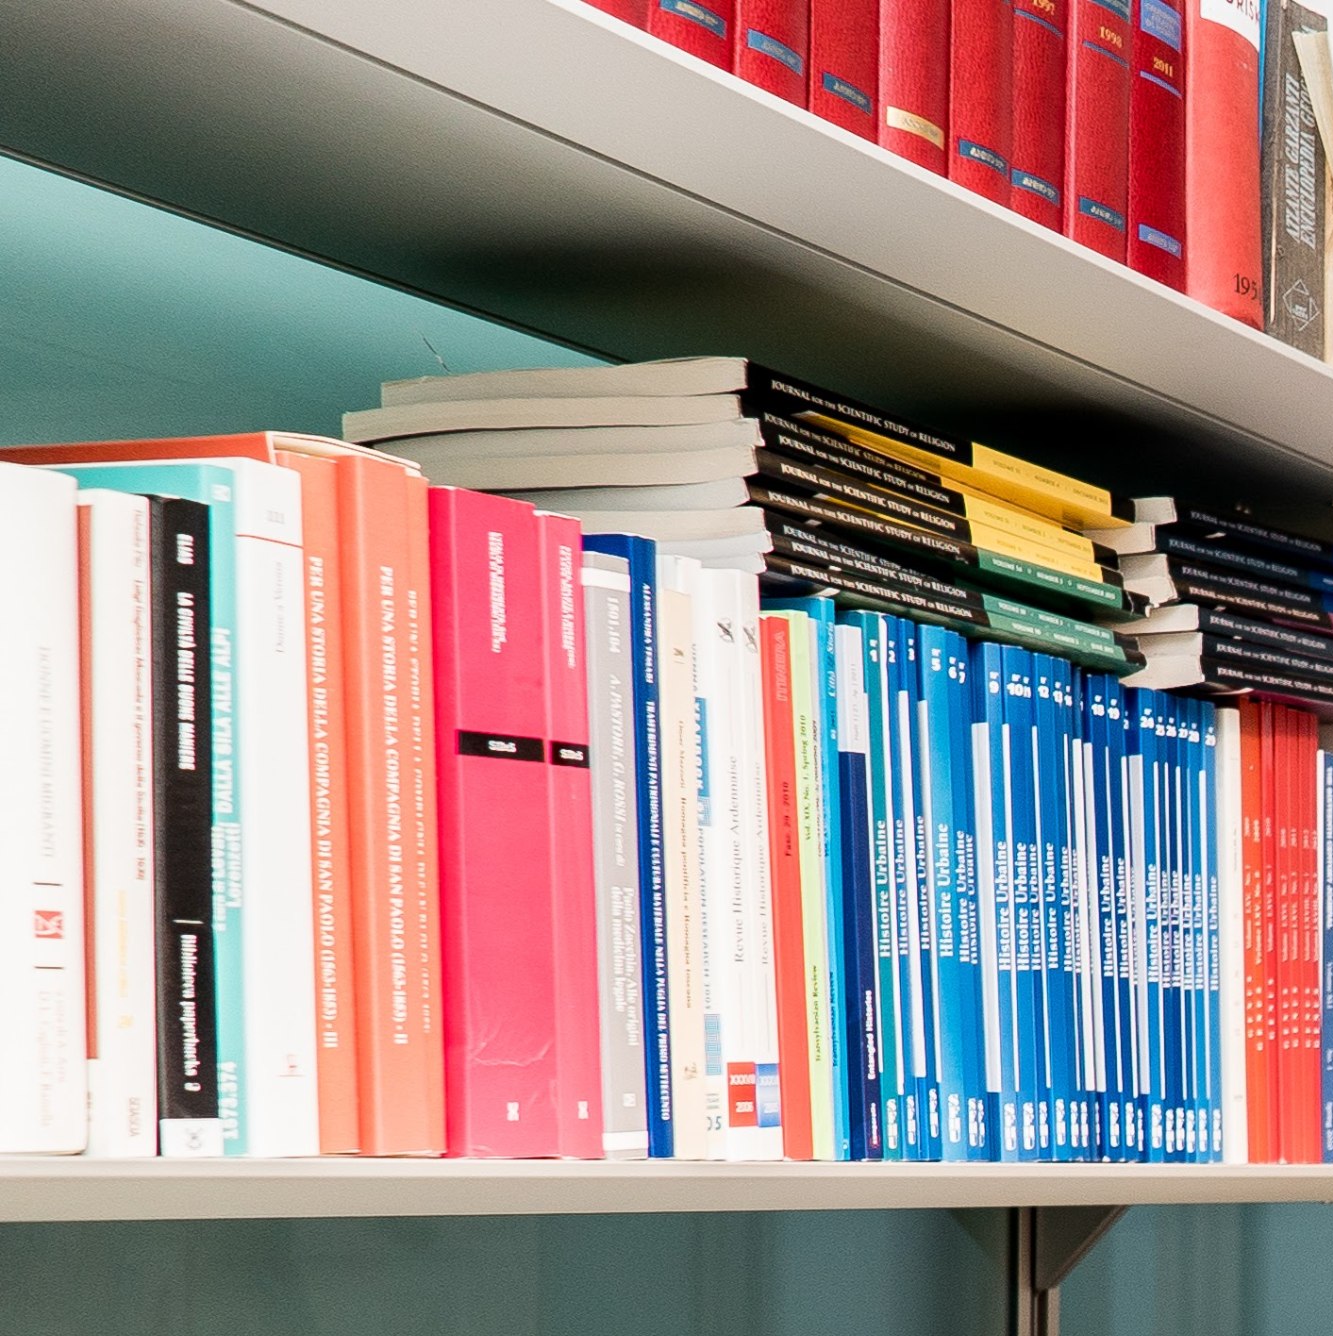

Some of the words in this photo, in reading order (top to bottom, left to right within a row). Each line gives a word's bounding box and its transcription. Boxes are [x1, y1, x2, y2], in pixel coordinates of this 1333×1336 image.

[1100, 26, 1123, 48] 1998
[1154, 57, 1173, 77] 2011
[1286, 73, 1300, 163] GARZANTI
[1286, 165, 1300, 242] ATLANTE
[1301, 132, 1316, 249] ENCICLOPEDIA
[771, 380, 809, 400] JOURNAL
[837, 404, 882, 426] SCIENTIFIC
[884, 418, 909, 435] STUDY
[919, 431, 955, 451] RELIGION
[778, 435, 814, 456] JOURNAL
[839, 457, 882, 480] SCIENTIFIC
[883, 471, 906, 488] STUDY
[915, 484, 949, 503] RELIGION
[781, 462, 817, 484] JOURNAL
[842, 484, 886, 508] SCIENTIFIC
[888, 498, 911, 516] STUDY
[921, 510, 956, 530] RELIGION
[177, 533, 194, 564] ELIAS
[768, 492, 808, 511] JOURNAL
[837, 510, 884, 533] SCIENTIFIC
[886, 525, 912, 541] STUDY
[922, 536, 959, 555] RELIGION
[792, 542, 828, 559] JOURNAL
[308, 556, 326, 588] PER
[379, 565, 396, 596] PER
[792, 564, 829, 583] JOURNAL
[855, 580, 901, 603] SCIENTIFIC
[902, 592, 927, 609] STUDY
[937, 601, 972, 619] RELIGION
[309, 590, 327, 624] UNA
[380, 598, 397, 633] UNA
[178, 650, 195, 682] DELLE
[212, 628, 231, 667] ALPI
[310, 626, 329, 685] STORIA
[381, 635, 399, 691] STORIA
[178, 684, 196, 720] BUONE
[212, 671, 231, 712] ALLE
[312, 687, 330, 739] DELLA
[179, 722, 196, 769] MANIERE
[212, 717, 232, 754] SILA
[383, 694, 400, 745] DELLA
[213, 760, 233, 813] DALLA
[313, 742, 333, 836] COMPAGNIA
[384, 748, 403, 841] COMPAGNIA
[728, 756, 740, 835] Ardennaise
[316, 839, 334, 857] DI
[387, 844, 404, 862] DI
[876, 821, 888, 885] Urbaine
[894, 820, 905, 884] Urbaine
[916, 816, 926, 879] Urbaine
[936, 824, 950, 887] Urbaine
[955, 832, 966, 892] Urbaine
[995, 842, 1008, 902] Urbaine
[317, 860, 335, 891] SAN
[388, 864, 405, 895] SAN
[730, 841, 742, 913] Historique
[318, 893, 336, 946] PAOLO
[389, 897, 406, 950] PAOLO
[732, 919, 744, 962] Revue
[879, 890, 890, 957] Histoire
[897, 890, 908, 955] Histoire
[918, 884, 930, 950] Histoire
[938, 893, 954, 957] Histoire
[958, 898, 970, 962] Histoire
[998, 906, 1011, 971] Histoire
[180, 934, 198, 997] Biblioteca
[811, 965, 819, 997] Review
[179, 1001, 201, 1075] paperbacks
[864, 990, 874, 1031] Histories
[866, 1034, 877, 1079] Entangled
